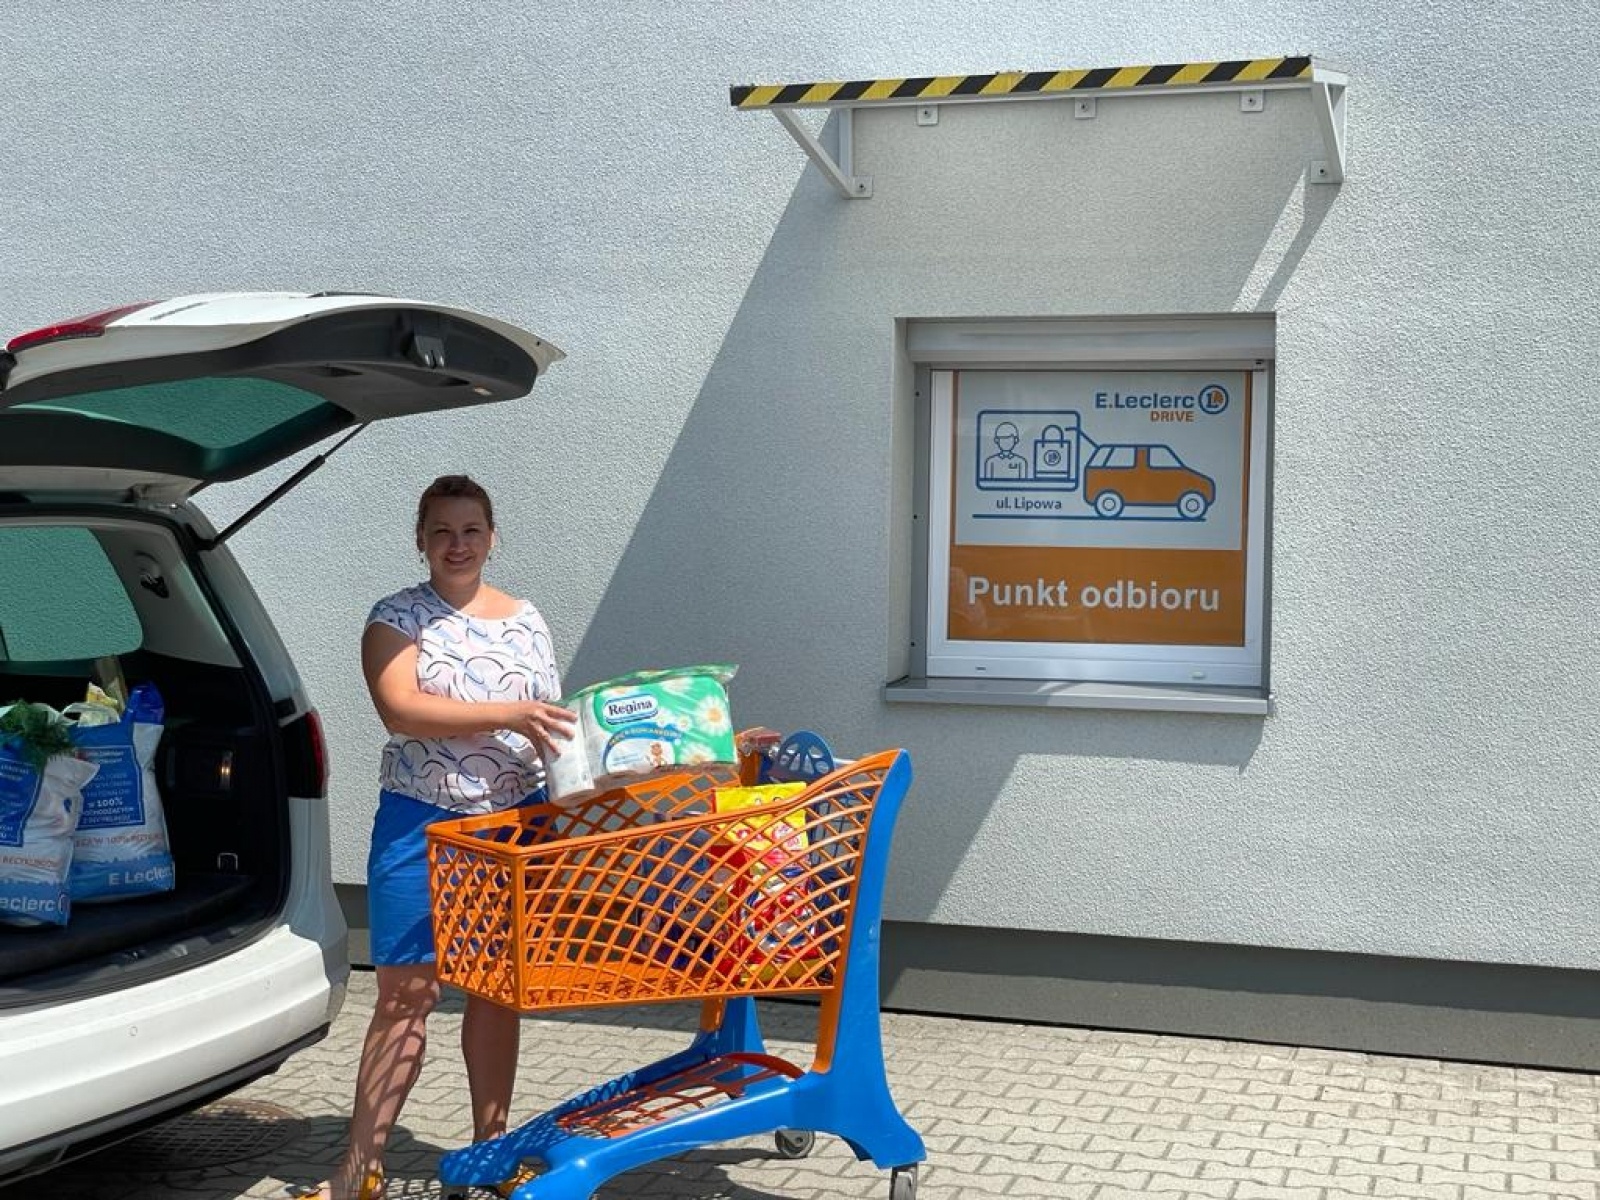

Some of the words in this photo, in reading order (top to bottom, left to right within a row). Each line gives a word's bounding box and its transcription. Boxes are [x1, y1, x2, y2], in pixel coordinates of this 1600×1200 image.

[1095, 392, 1195, 409] E.Leclerc
[1150, 410, 1195, 422] DRIVE
[996, 497, 1011, 509] ul.
[1014, 497, 1062, 511] Lipowa
[968, 576, 1068, 607] Punkt
[1080, 580, 1220, 611] odbioru
[609, 701, 653, 716] Regina
